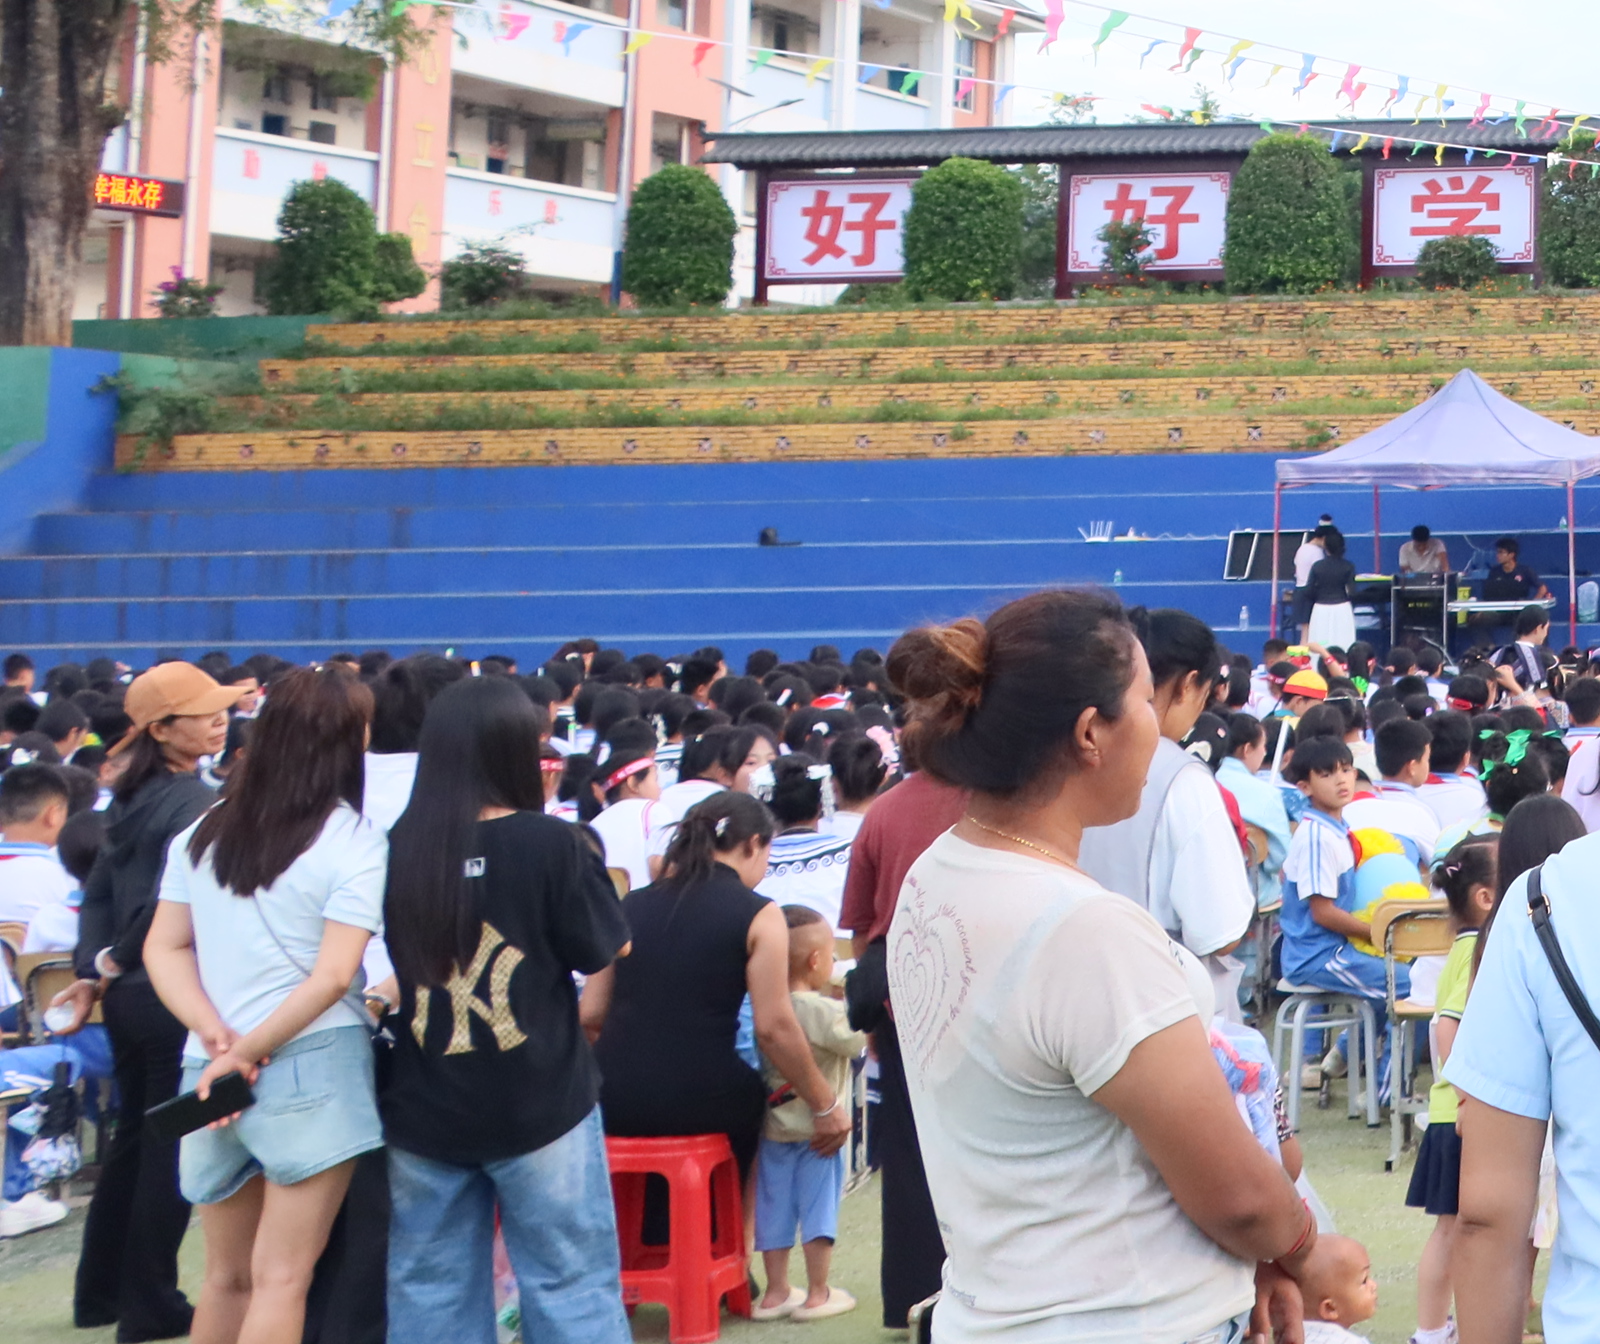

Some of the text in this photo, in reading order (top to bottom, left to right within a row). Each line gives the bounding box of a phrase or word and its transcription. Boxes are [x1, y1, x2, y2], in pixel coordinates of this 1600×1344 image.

[801, 189, 896, 267] 好
[1104, 183, 1199, 260] 好
[1410, 175, 1501, 238] 学
